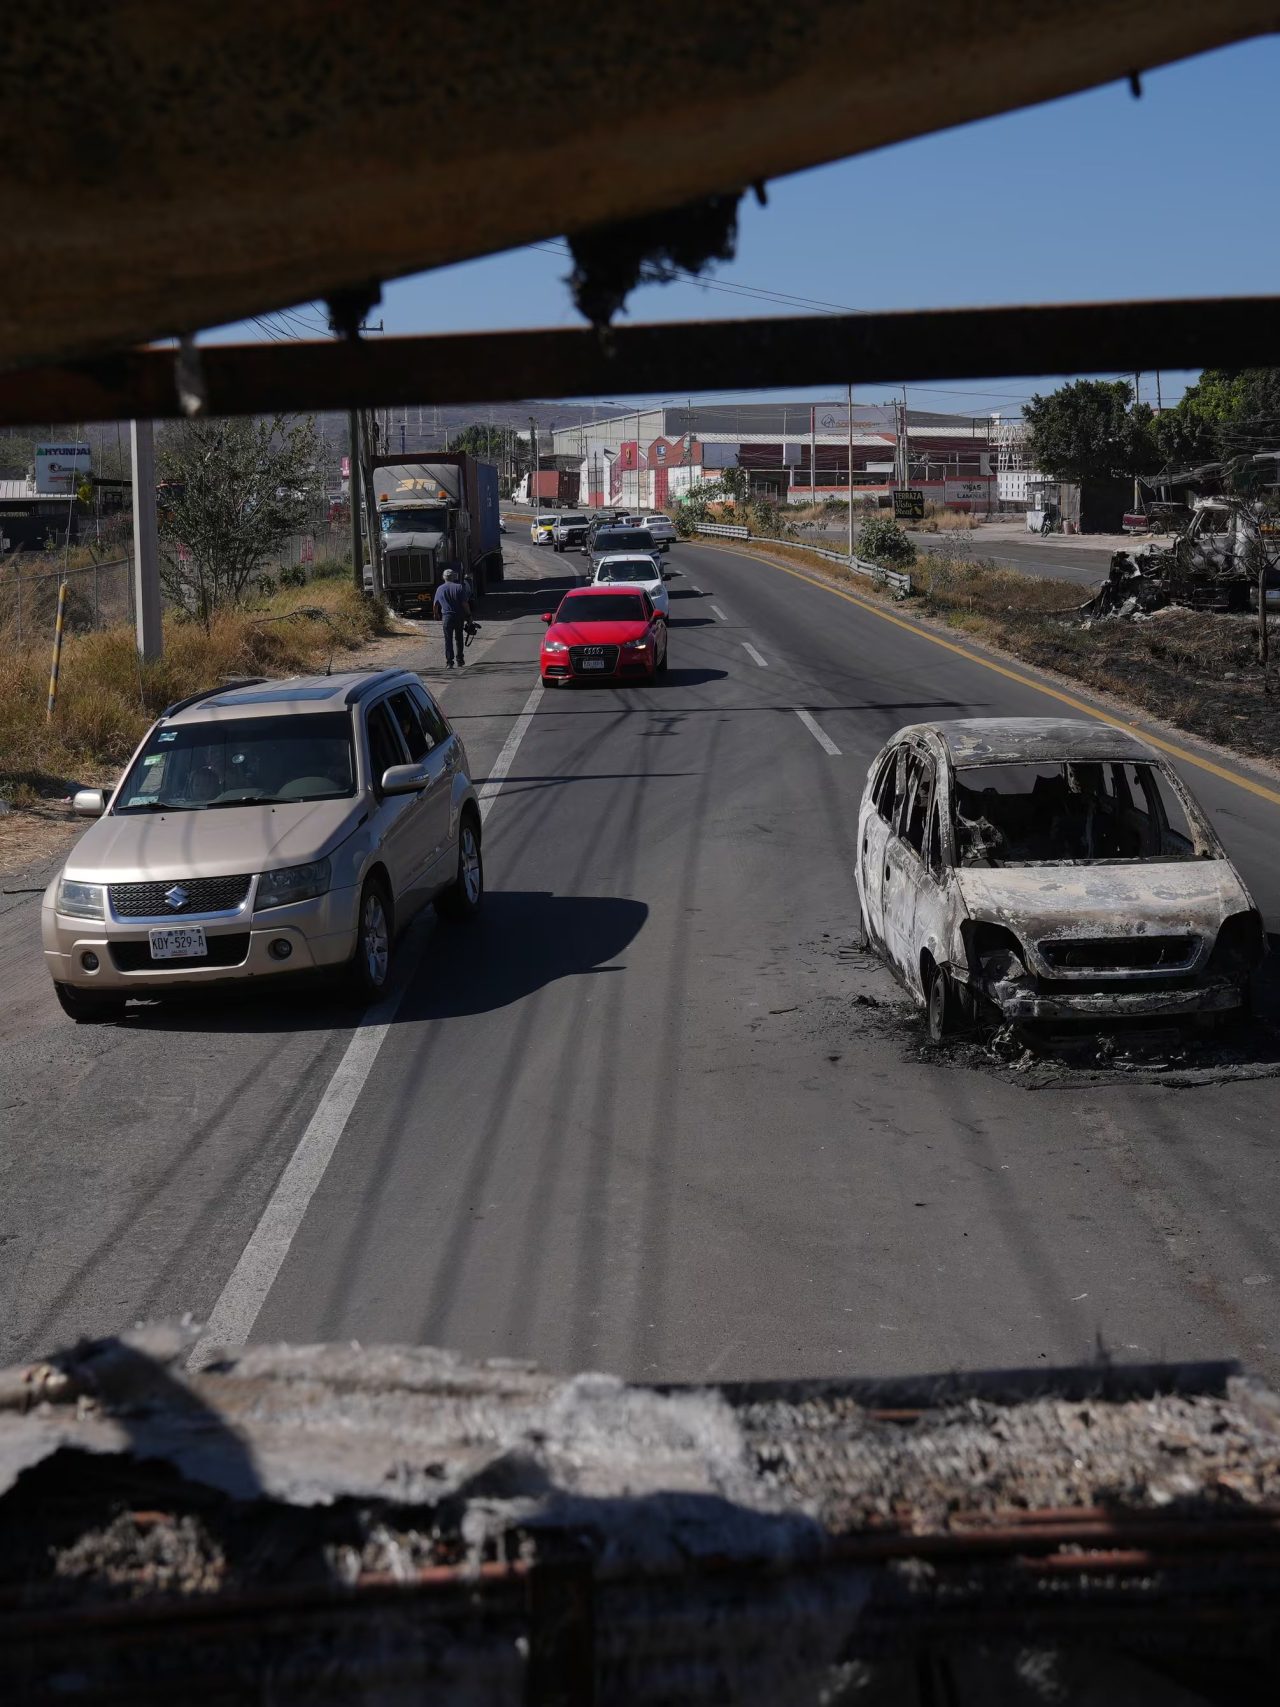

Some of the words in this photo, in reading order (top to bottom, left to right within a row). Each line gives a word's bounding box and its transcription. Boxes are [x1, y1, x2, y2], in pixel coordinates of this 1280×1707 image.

[45, 448, 91, 456] HYUNDAI
[895, 492, 922, 500] TERRAZA
[895, 499, 912, 508] Vista
